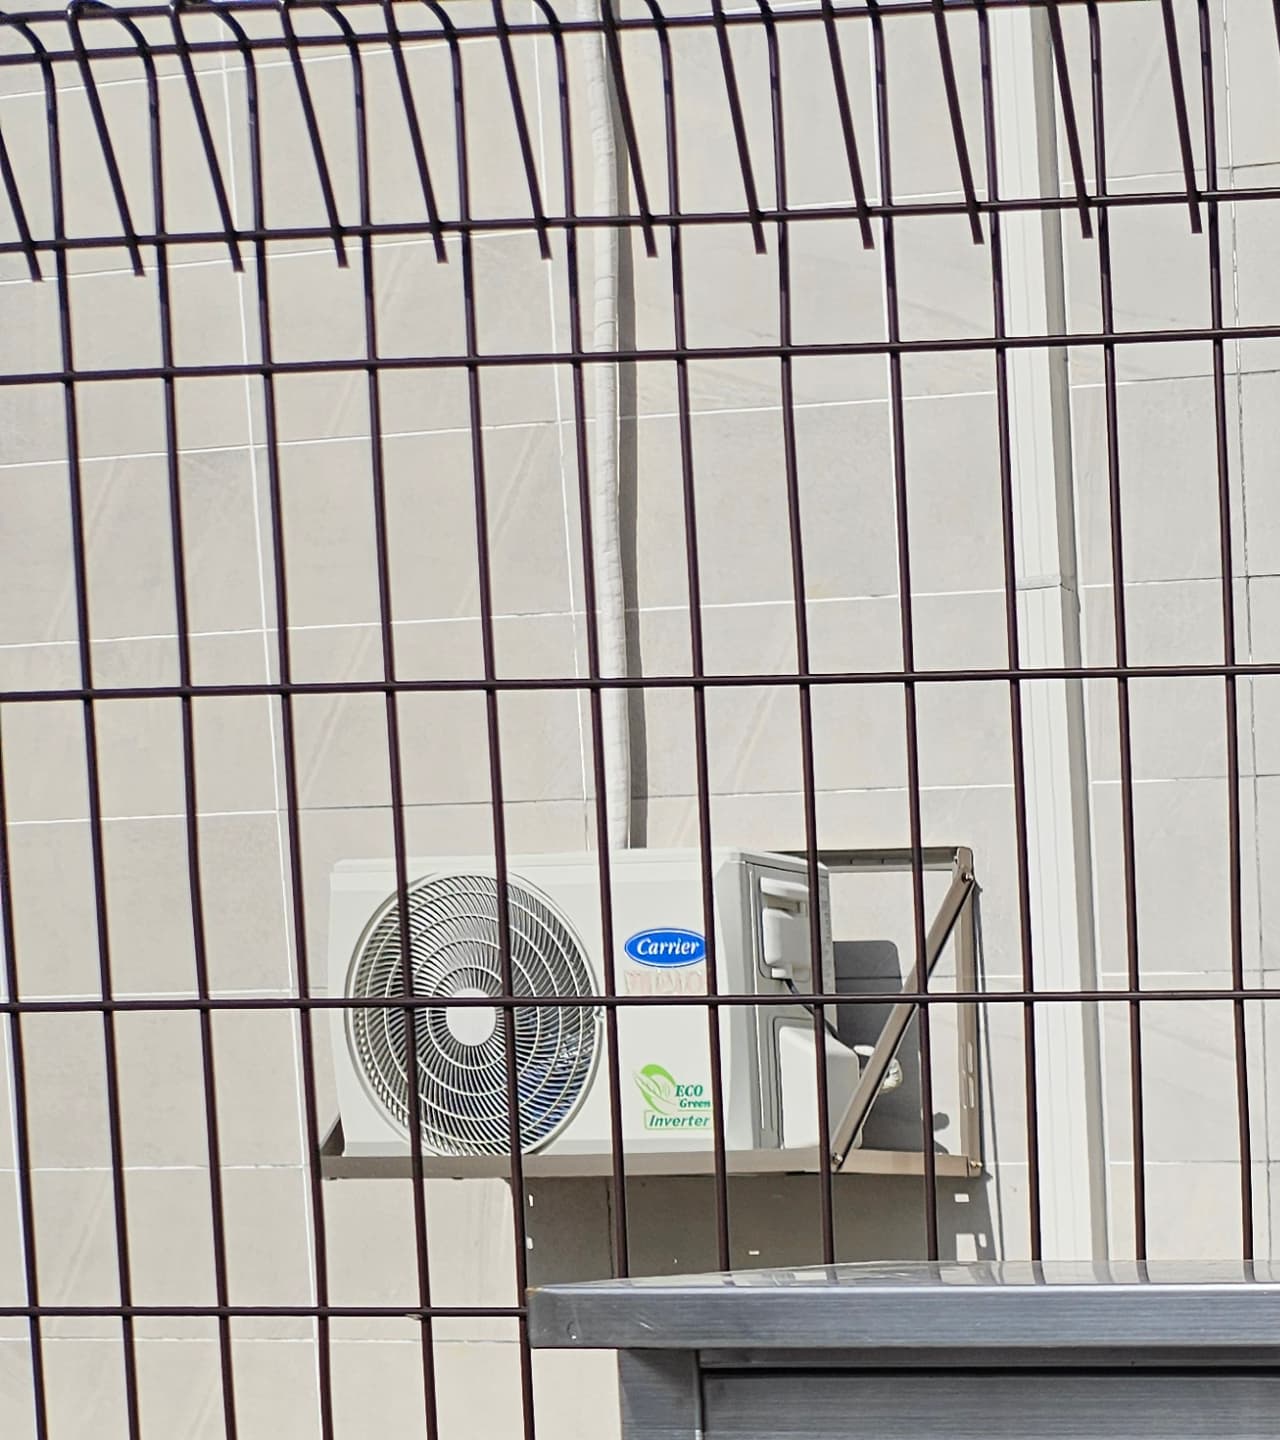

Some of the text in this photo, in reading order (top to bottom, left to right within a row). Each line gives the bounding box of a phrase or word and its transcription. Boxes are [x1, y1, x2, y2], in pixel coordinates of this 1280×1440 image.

[637, 937, 700, 956] Carrier
[675, 1084, 703, 1097] ECO
[679, 1099, 711, 1108] Green
[650, 1115, 710, 1127] Inverter
